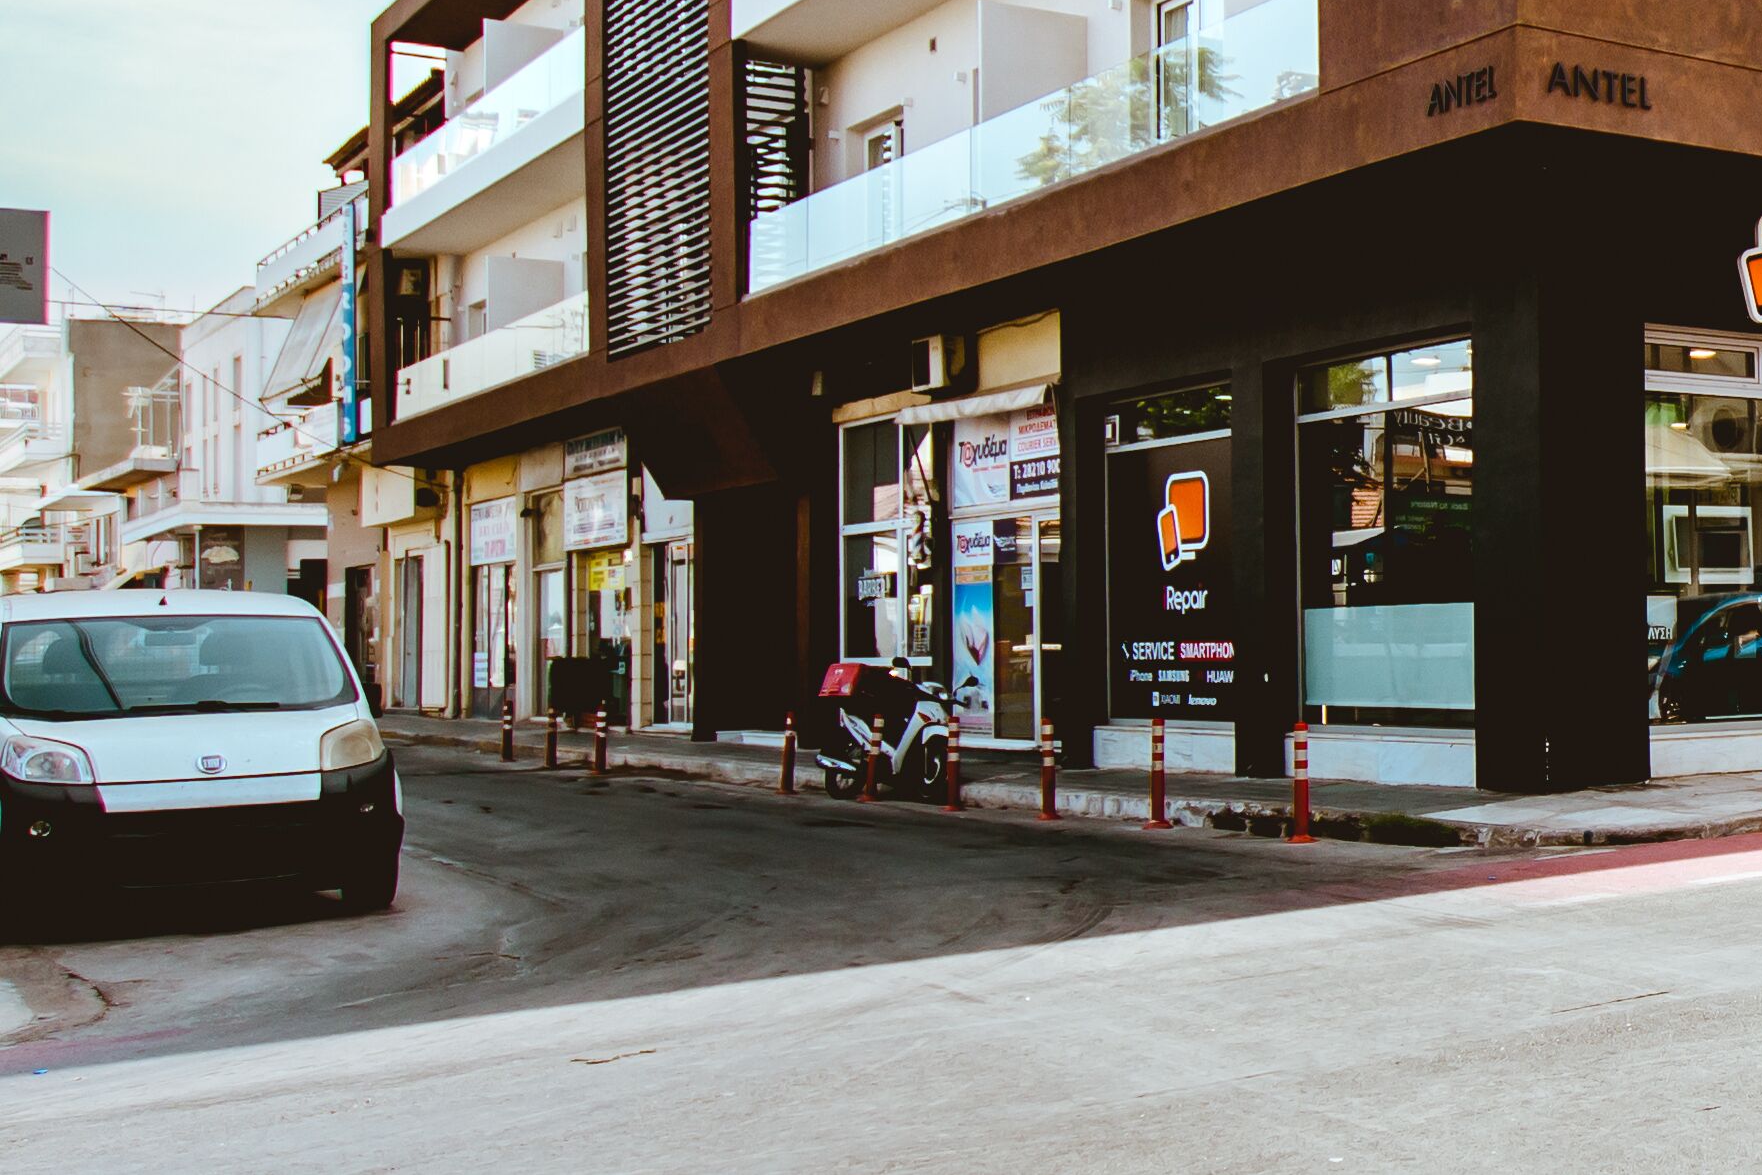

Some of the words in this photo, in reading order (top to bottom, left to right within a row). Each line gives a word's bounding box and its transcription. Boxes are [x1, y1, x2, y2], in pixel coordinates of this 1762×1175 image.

[1427, 65, 1497, 117] ANTEL
[1547, 62, 1652, 111] ANTEL
[1022, 460, 1046, 478] 28210
[1132, 641, 1175, 660] SERVICE
[1129, 669, 1153, 682] iPhone
[1158, 669, 1190, 682] SAMSUNG
[1188, 693, 1217, 706] lenovo
